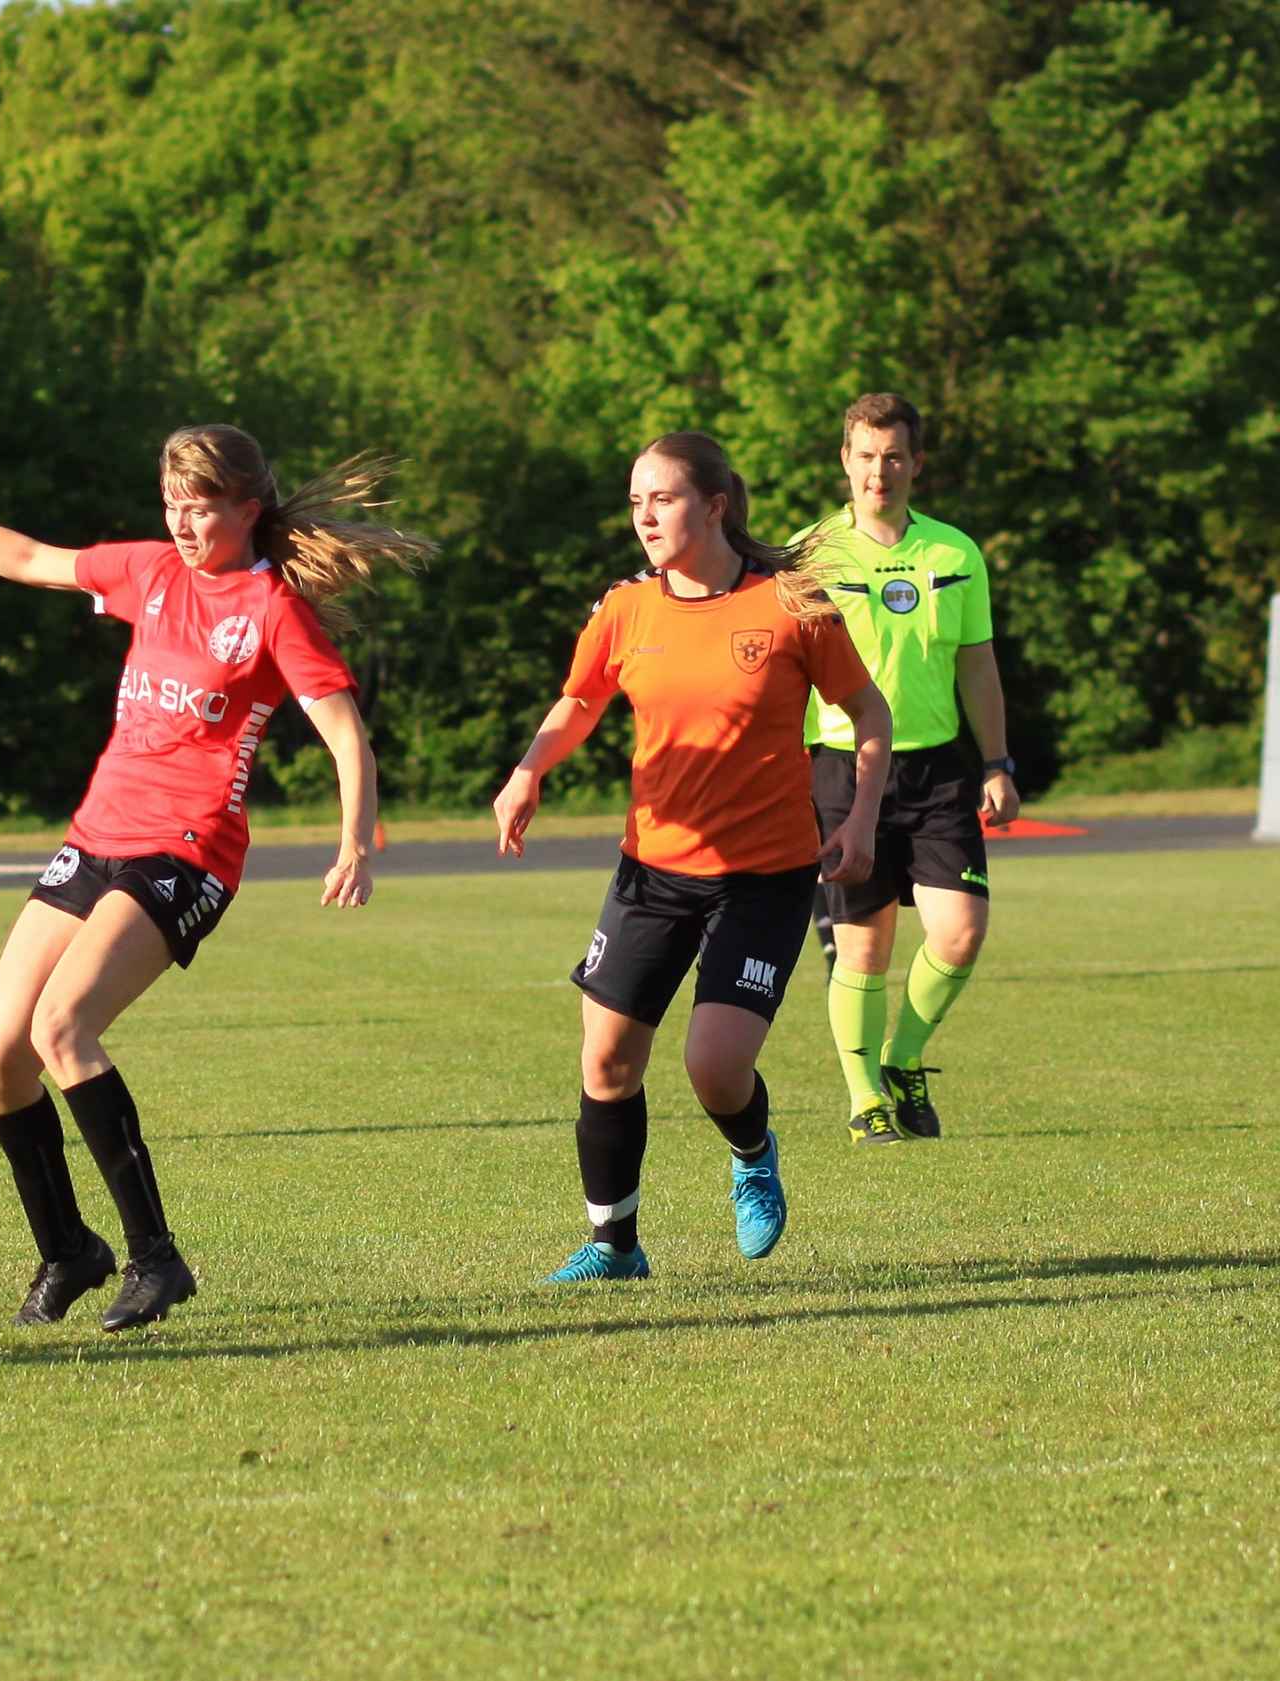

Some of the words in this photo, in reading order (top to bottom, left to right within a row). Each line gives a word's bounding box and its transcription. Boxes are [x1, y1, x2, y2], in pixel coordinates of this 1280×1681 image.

[159, 677, 229, 723] SKO
[735, 979, 769, 996] CRAFT
[742, 956, 777, 992] MK
